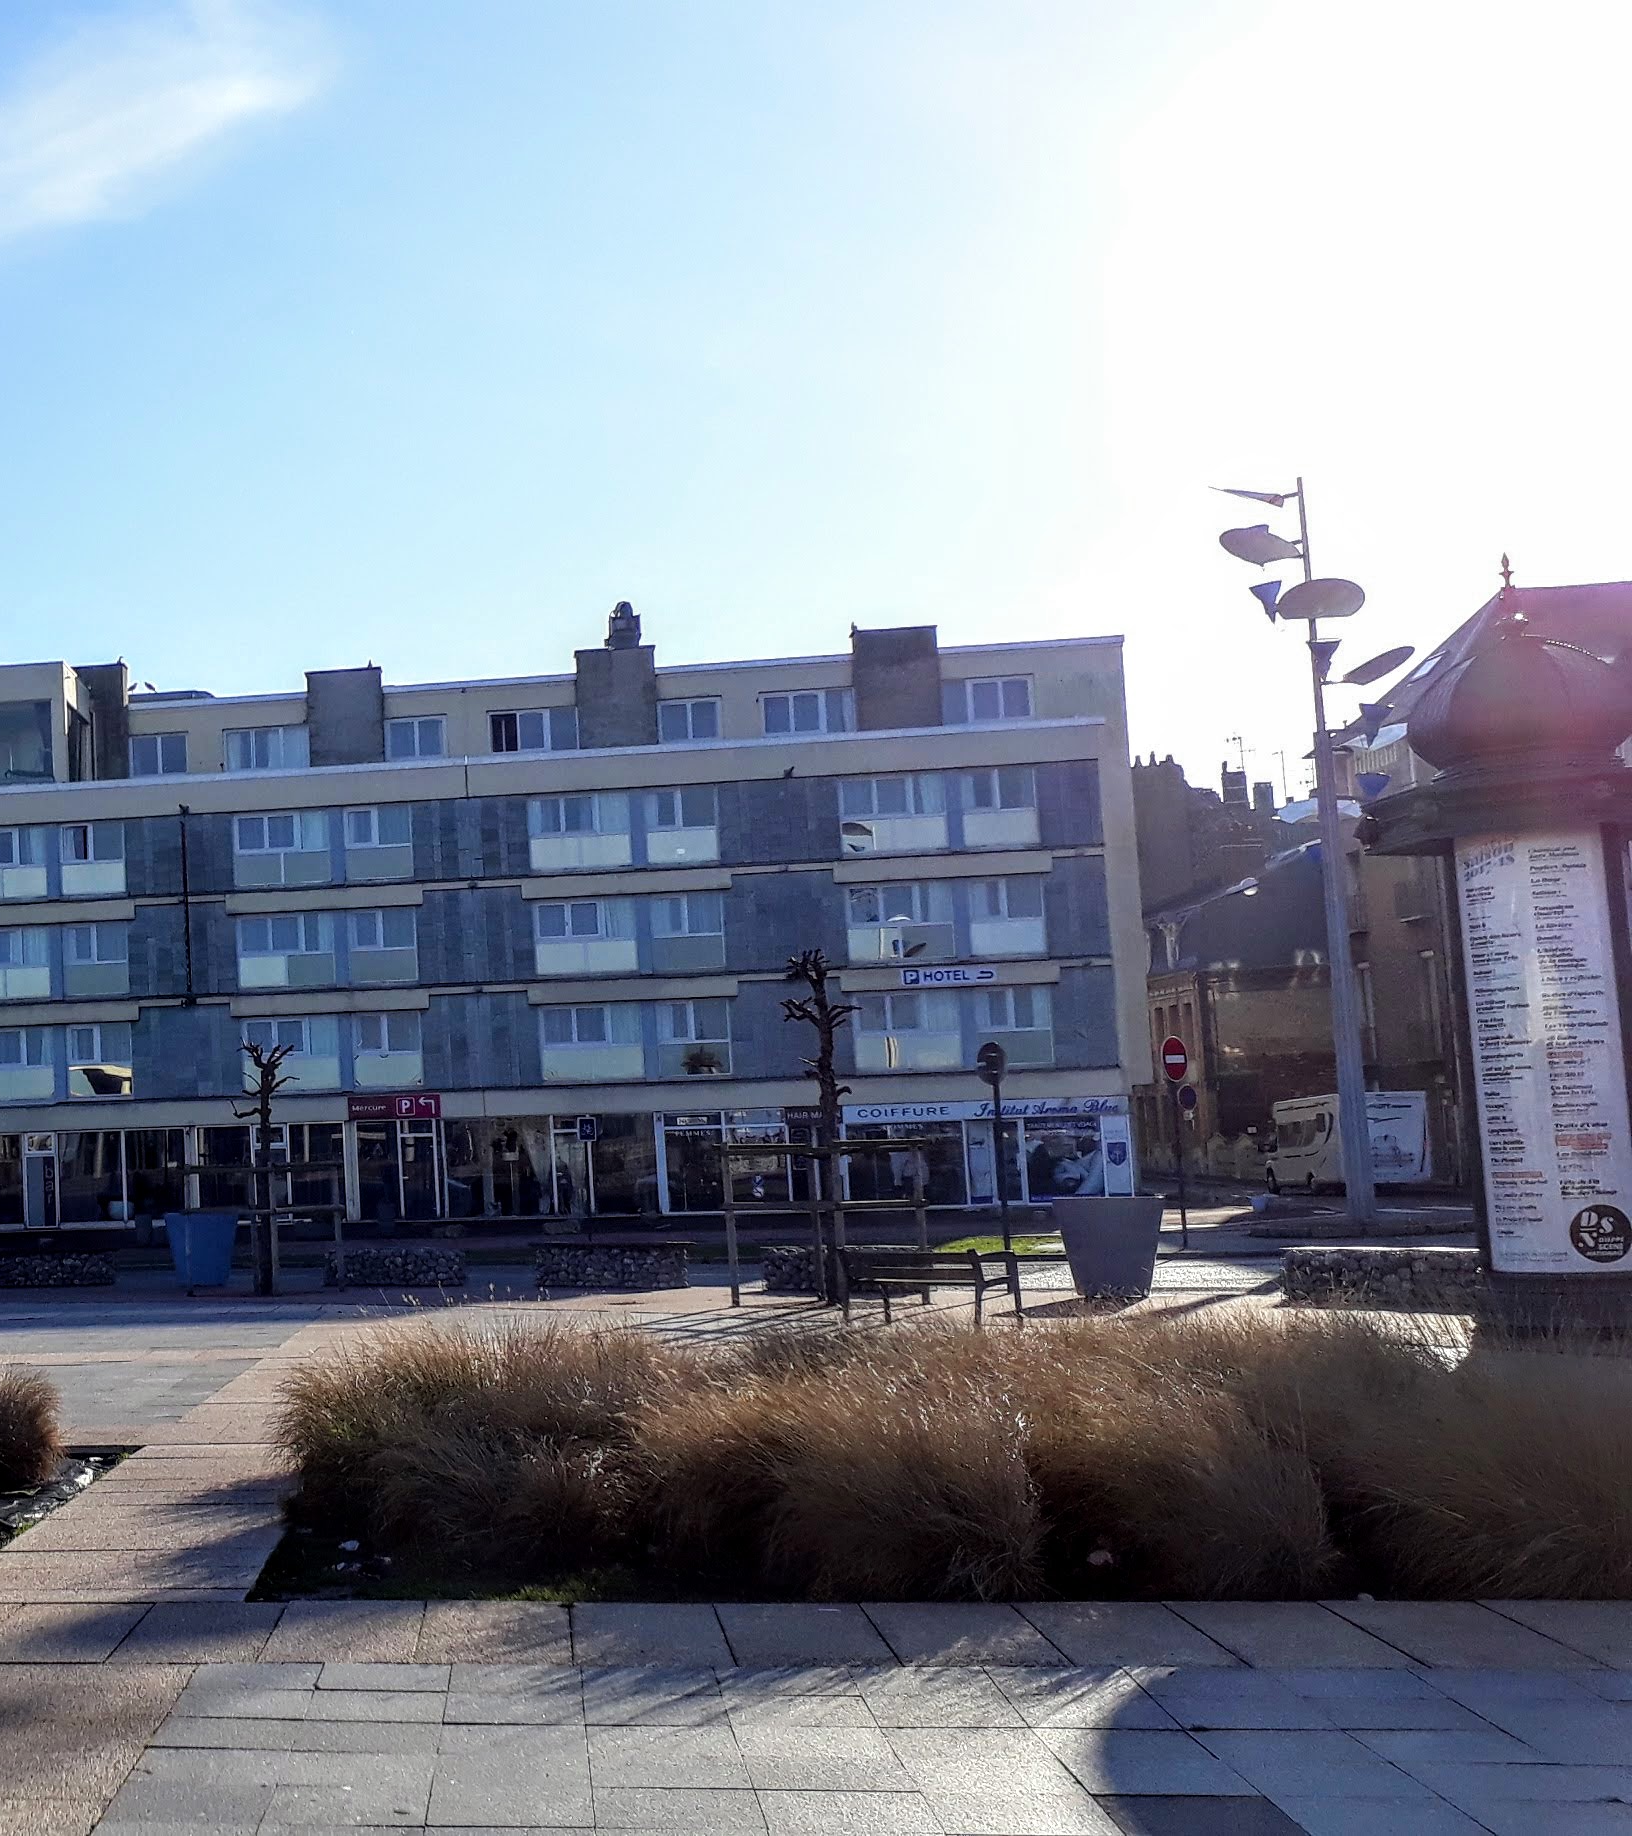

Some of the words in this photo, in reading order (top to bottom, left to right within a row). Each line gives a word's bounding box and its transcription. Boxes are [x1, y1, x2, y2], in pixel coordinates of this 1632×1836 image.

[923, 969, 971, 982] HOTEL
[351, 1104, 387, 1112] Mercure
[857, 1106, 950, 1119] COIFFURE
[1083, 1099, 1119, 1113] Blue
[44, 1164, 54, 1204] bar
